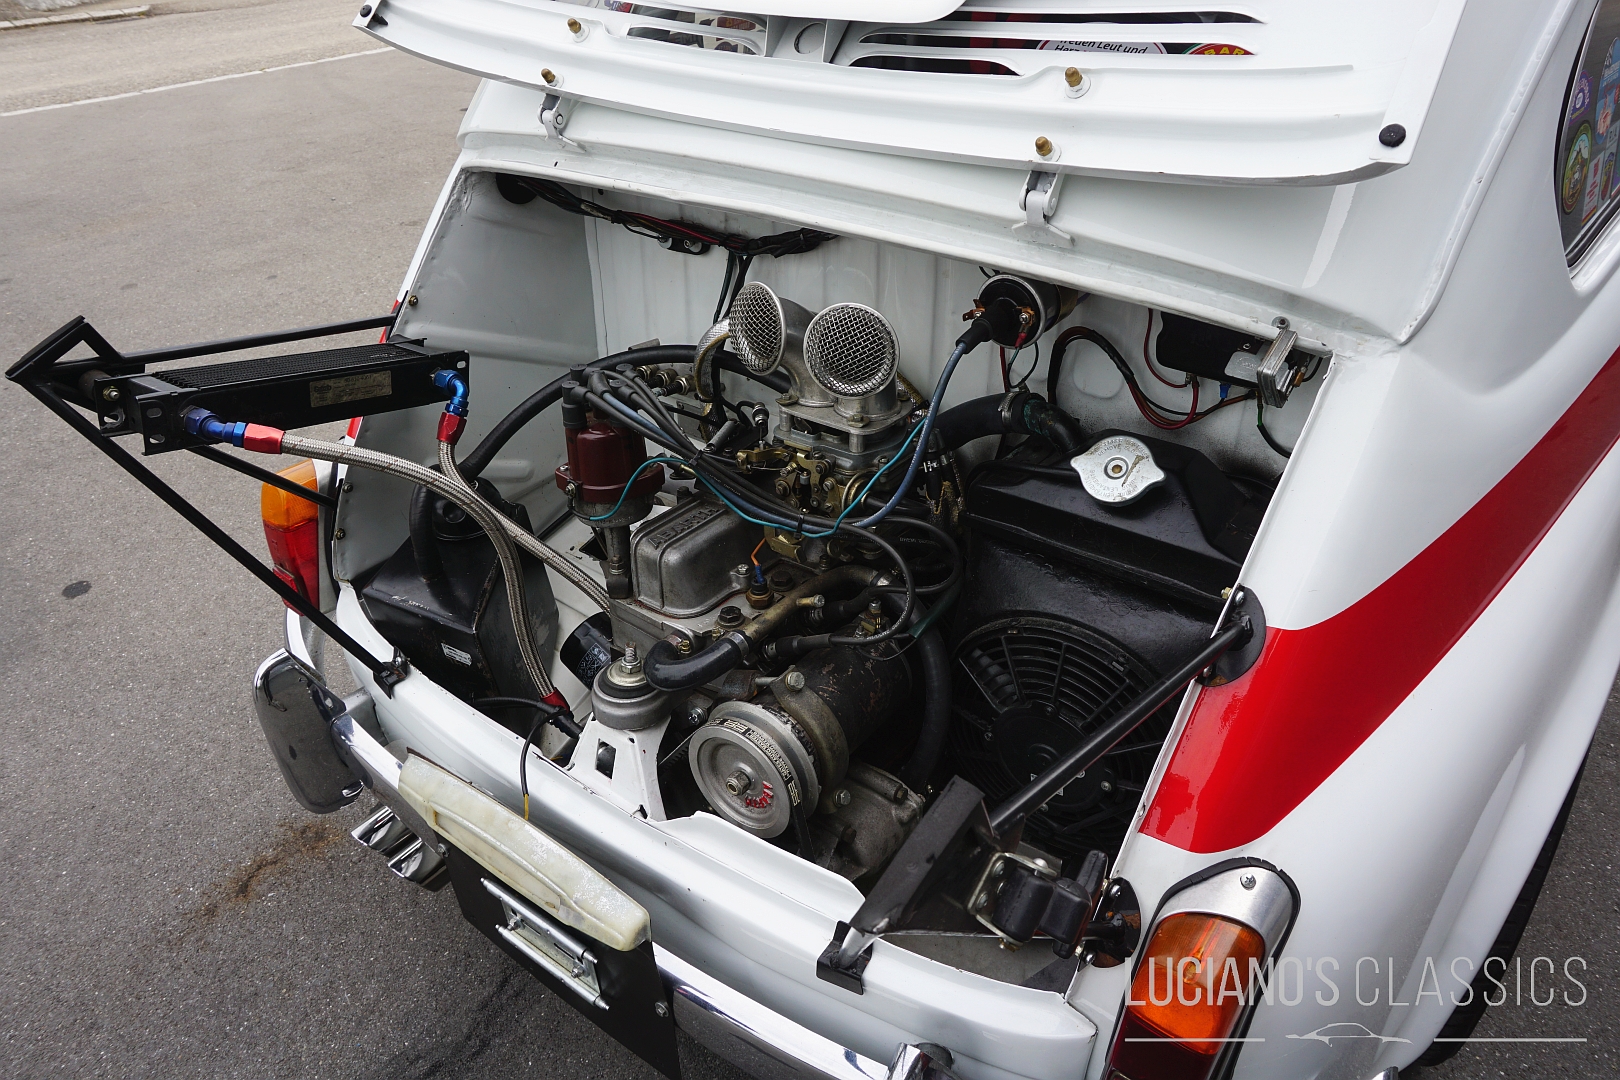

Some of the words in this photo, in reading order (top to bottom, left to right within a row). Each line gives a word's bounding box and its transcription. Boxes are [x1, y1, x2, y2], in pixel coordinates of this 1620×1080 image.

[1097, 41, 1123, 52] Leut
[1123, 46, 1148, 54] und
[648, 507, 719, 550] ABARTH
